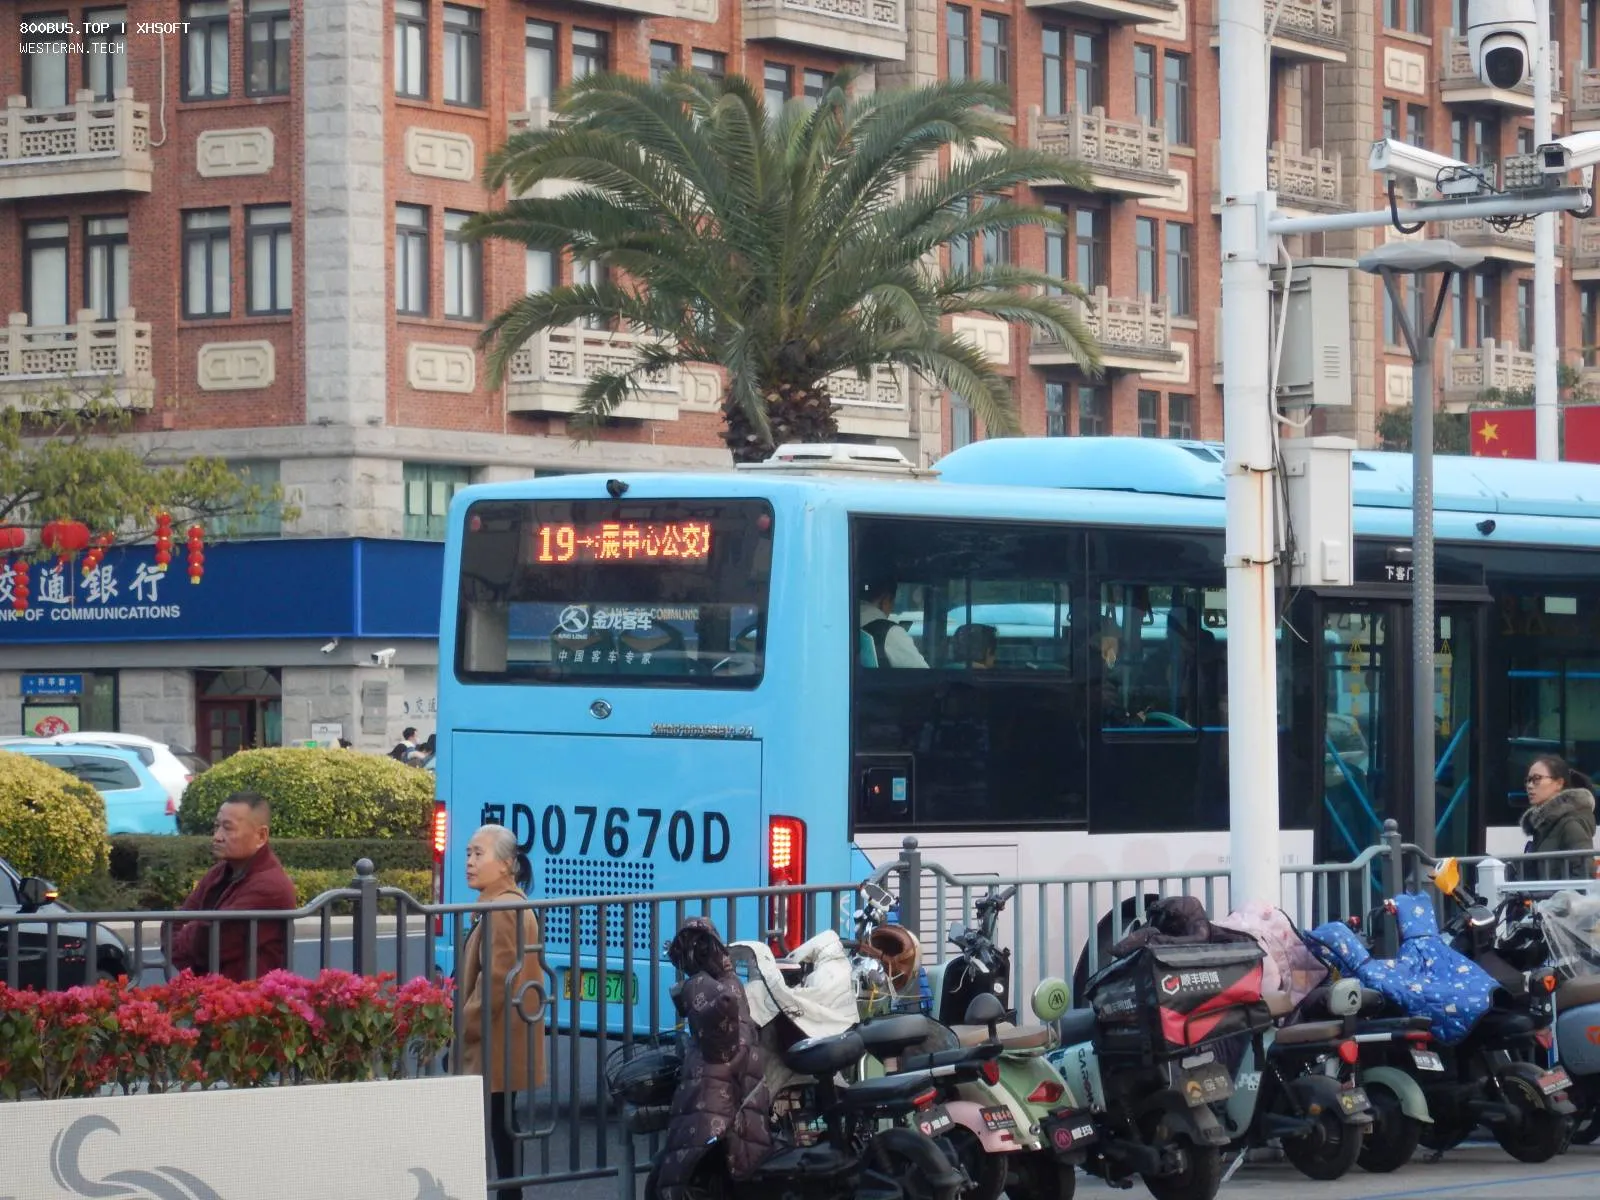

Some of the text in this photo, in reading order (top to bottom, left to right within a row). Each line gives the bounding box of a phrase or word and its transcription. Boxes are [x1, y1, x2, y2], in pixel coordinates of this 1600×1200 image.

[538, 526, 575, 562] 19
[24, 608, 44, 622] OF
[50, 605, 181, 621] COMMUNICATIONS
[591, 610, 653, 631] 金龙客车
[558, 649, 653, 665] 中国客车专家
